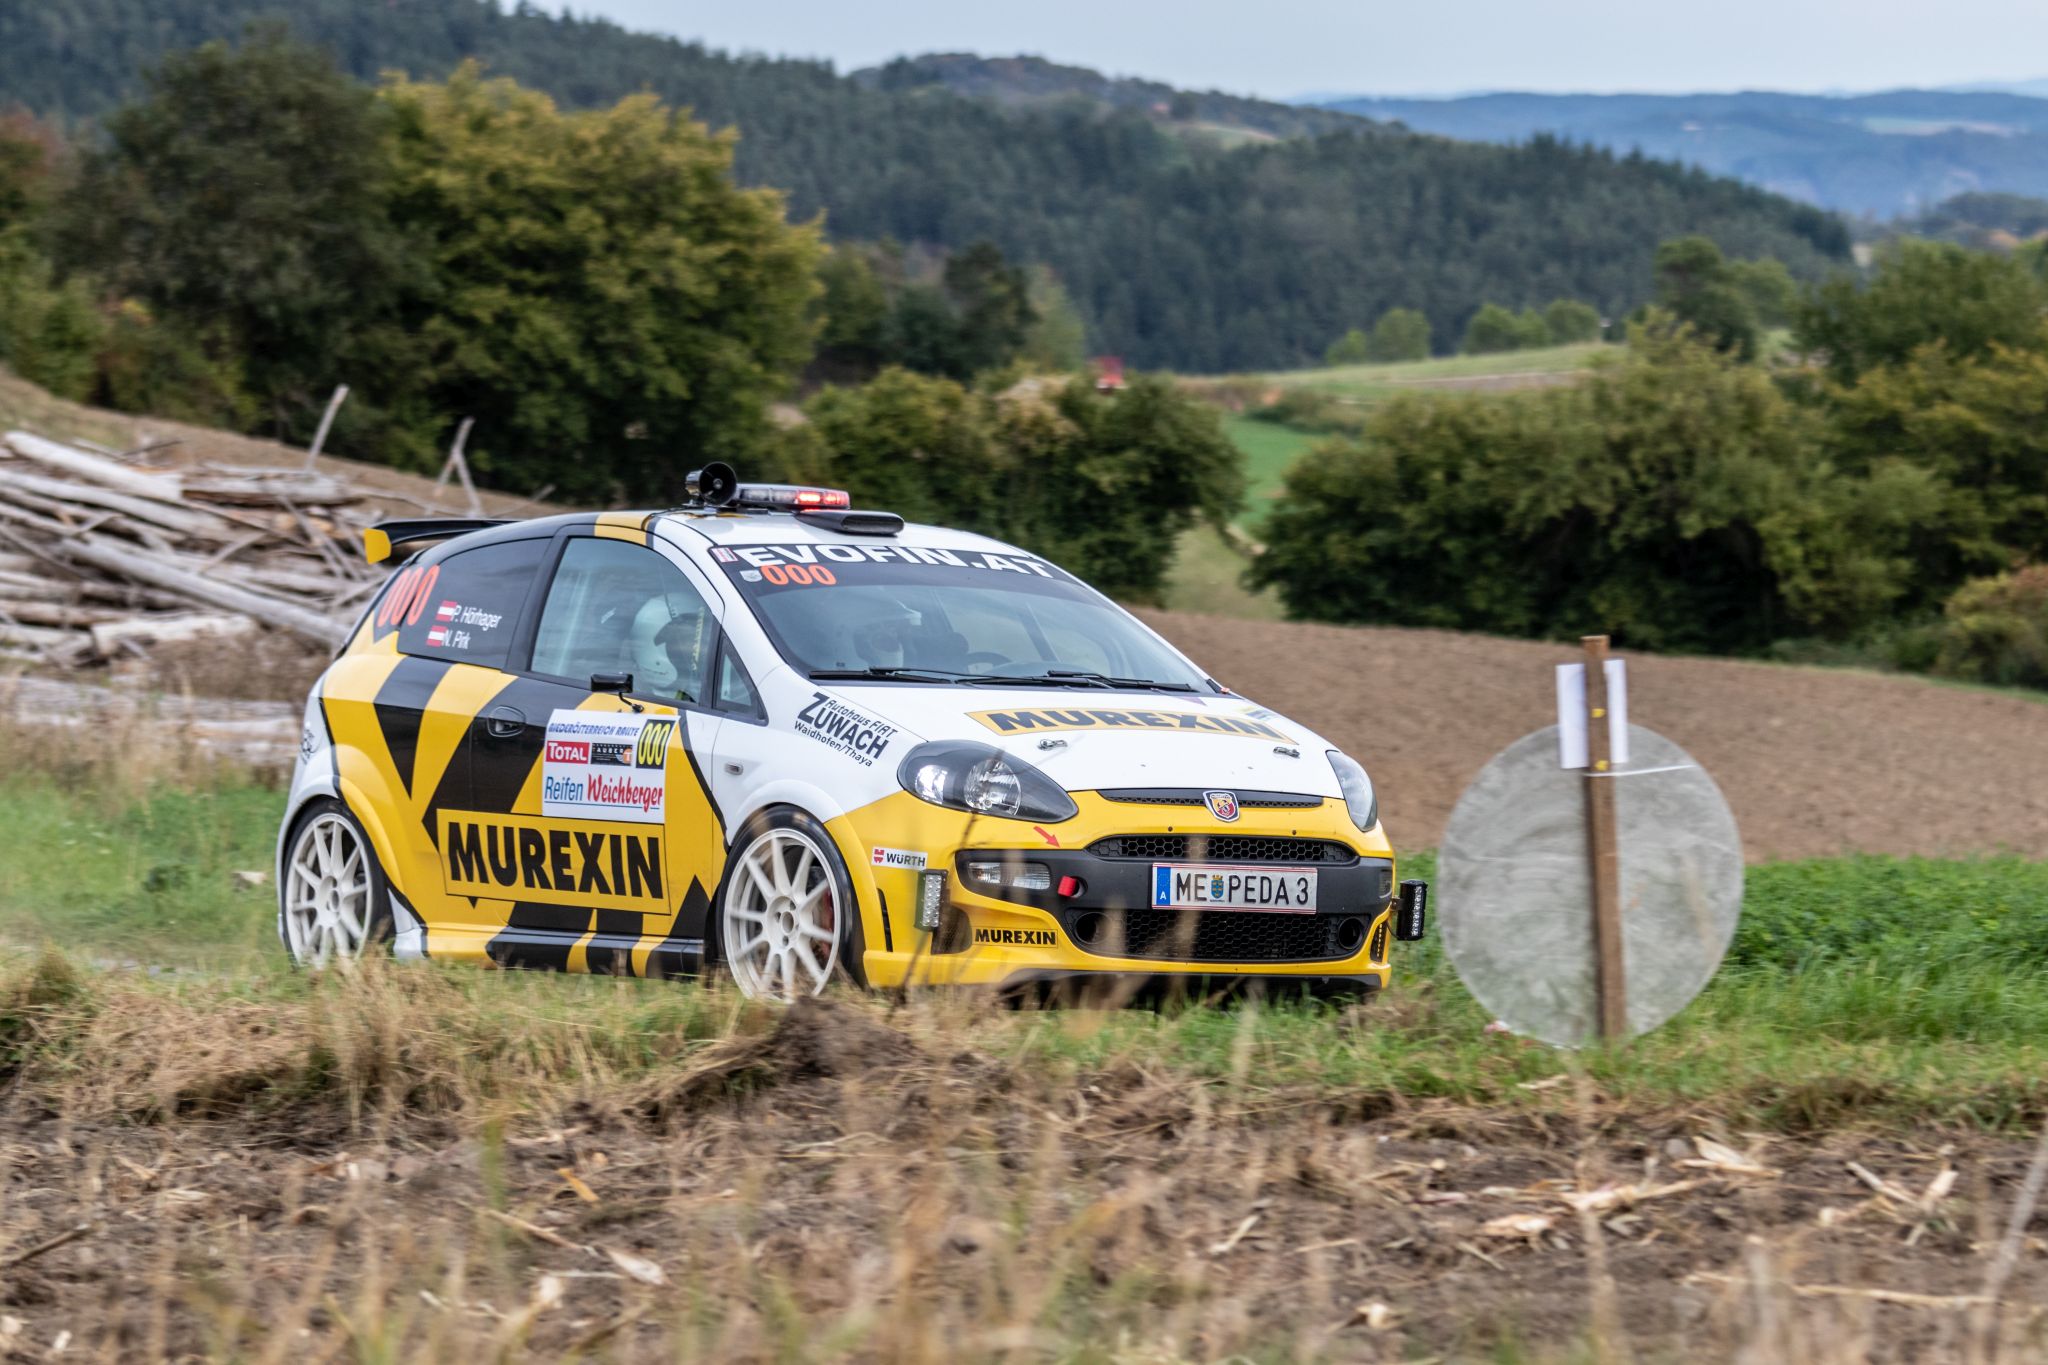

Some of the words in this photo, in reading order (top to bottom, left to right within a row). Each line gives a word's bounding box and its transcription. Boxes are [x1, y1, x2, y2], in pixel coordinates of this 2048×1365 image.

[733, 544, 1054, 578] EVOFIN.AT
[761, 564, 837, 586] 000
[376, 564, 440, 628] 000
[450, 604, 462, 622] P.
[797, 691, 890, 760] ZUWACH
[825, 699, 871, 726] Autohaus
[869, 720, 899, 738] FIAT
[986, 710, 1286, 739] MUREXIN
[548, 742, 587, 761] TOTAL
[638, 722, 671, 766] 000
[794, 720, 873, 767] Waidhofen/Thaya
[544, 776, 584, 802] Reifen
[587, 773, 663, 813] Weichberger
[448, 821, 664, 899] MUREXIN
[886, 852, 926, 867] WÜRTH
[1176, 872, 1208, 902] ME
[1228, 874, 1290, 905] PEDA
[1296, 877, 1309, 905] 3
[975, 928, 1056, 945] MUREXIN
